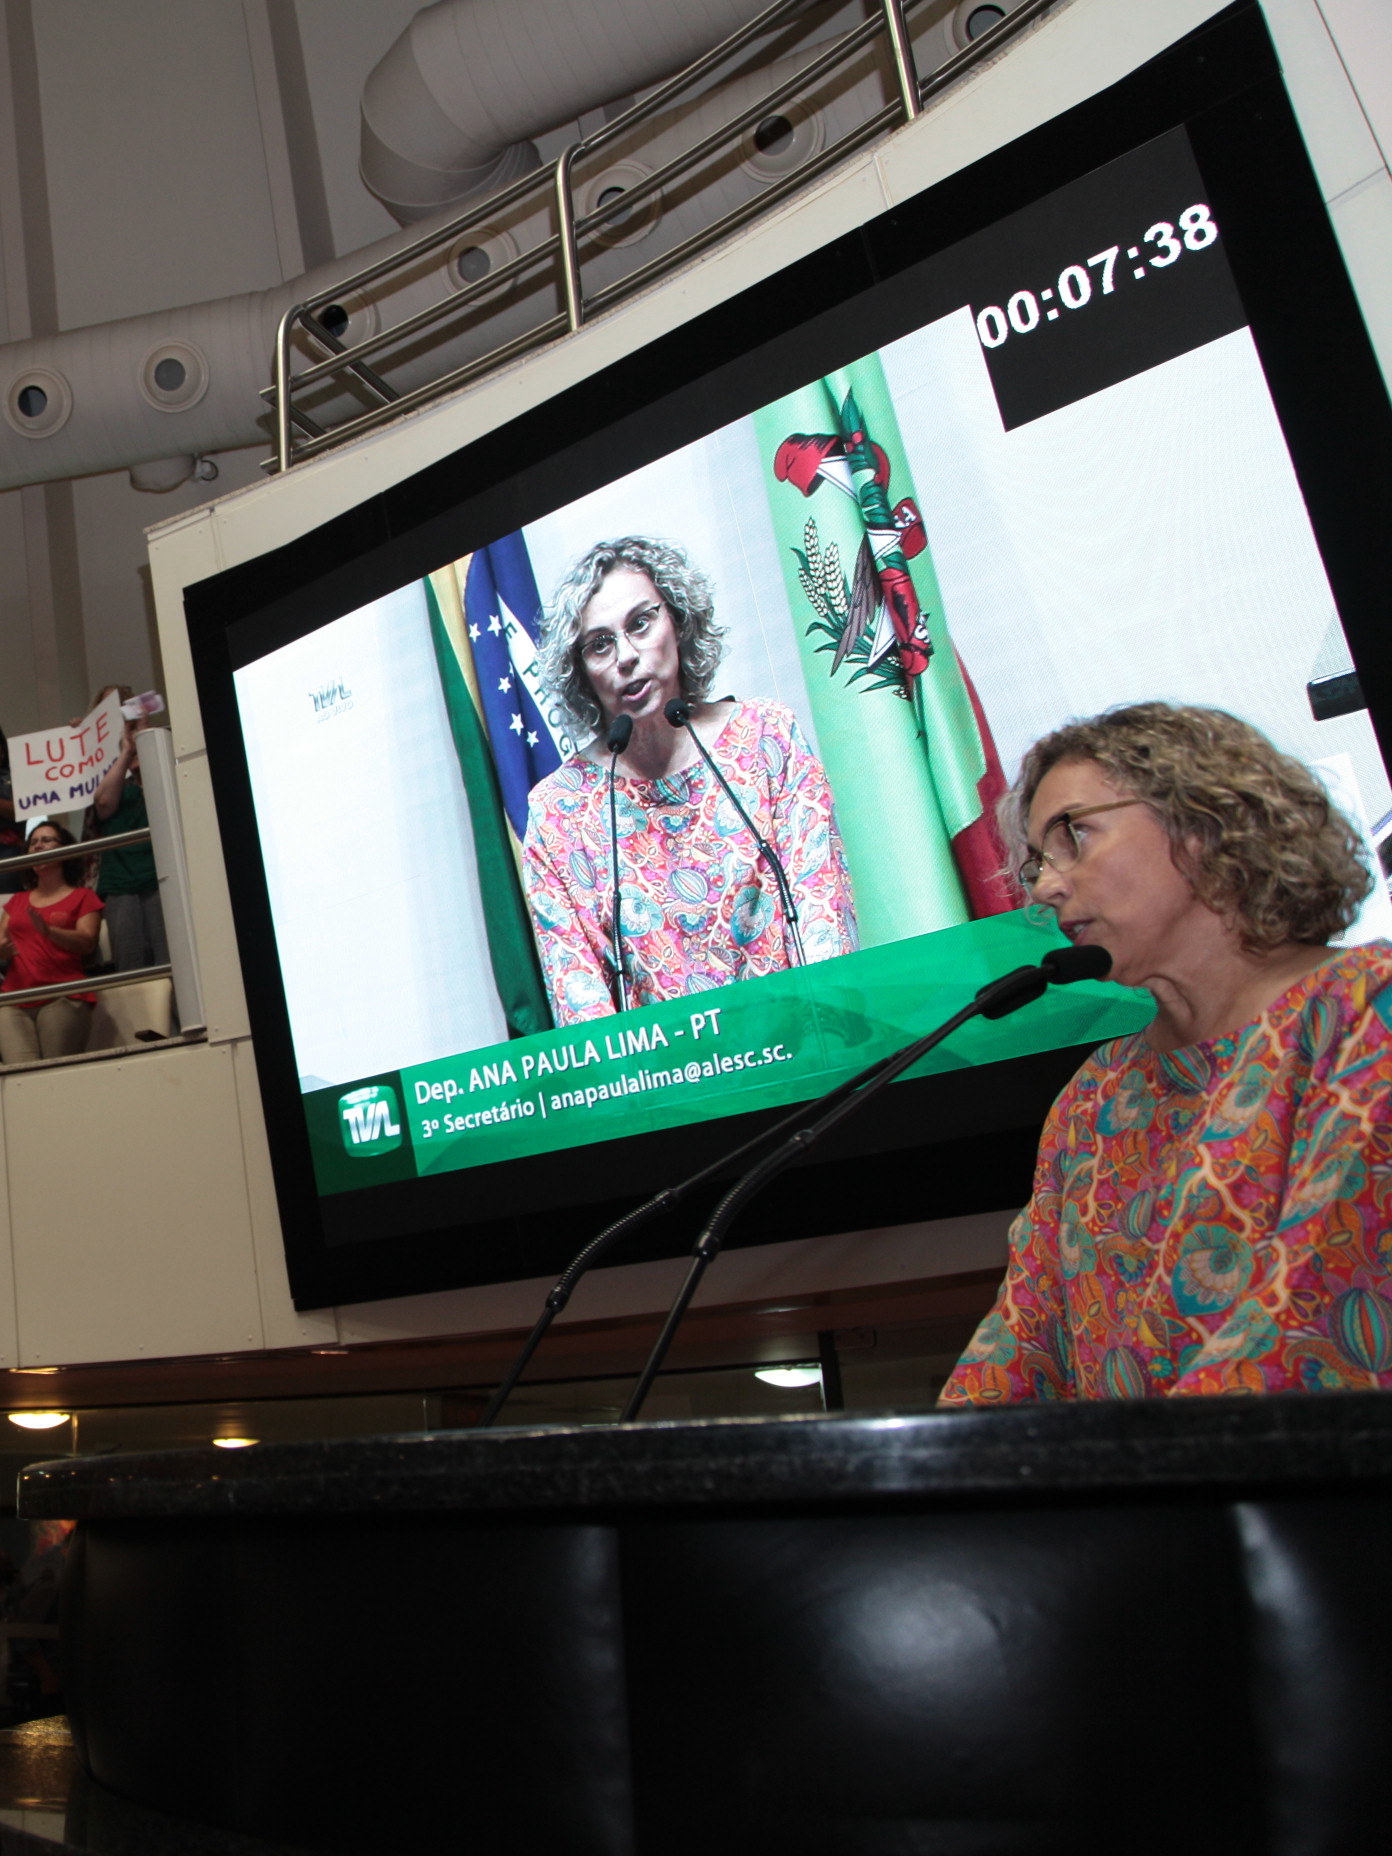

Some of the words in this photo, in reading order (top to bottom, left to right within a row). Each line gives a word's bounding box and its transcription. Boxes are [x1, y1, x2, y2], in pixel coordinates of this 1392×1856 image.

[976, 203, 1219, 349] 00:07:38
[24, 711, 110, 766] LUTE
[44, 747, 105, 782] COMO
[18, 790, 61, 810] UMA
[414, 1080, 465, 1105] Dep.
[469, 1060, 518, 1093] ANA
[521, 1039, 602, 1080] PAULA
[605, 1023, 670, 1060] LIMA
[690, 1008, 722, 1040] PT
[443, 1098, 536, 1134] Secretário
[550, 1044, 794, 1109] anapaulalima@alesc.sc.
